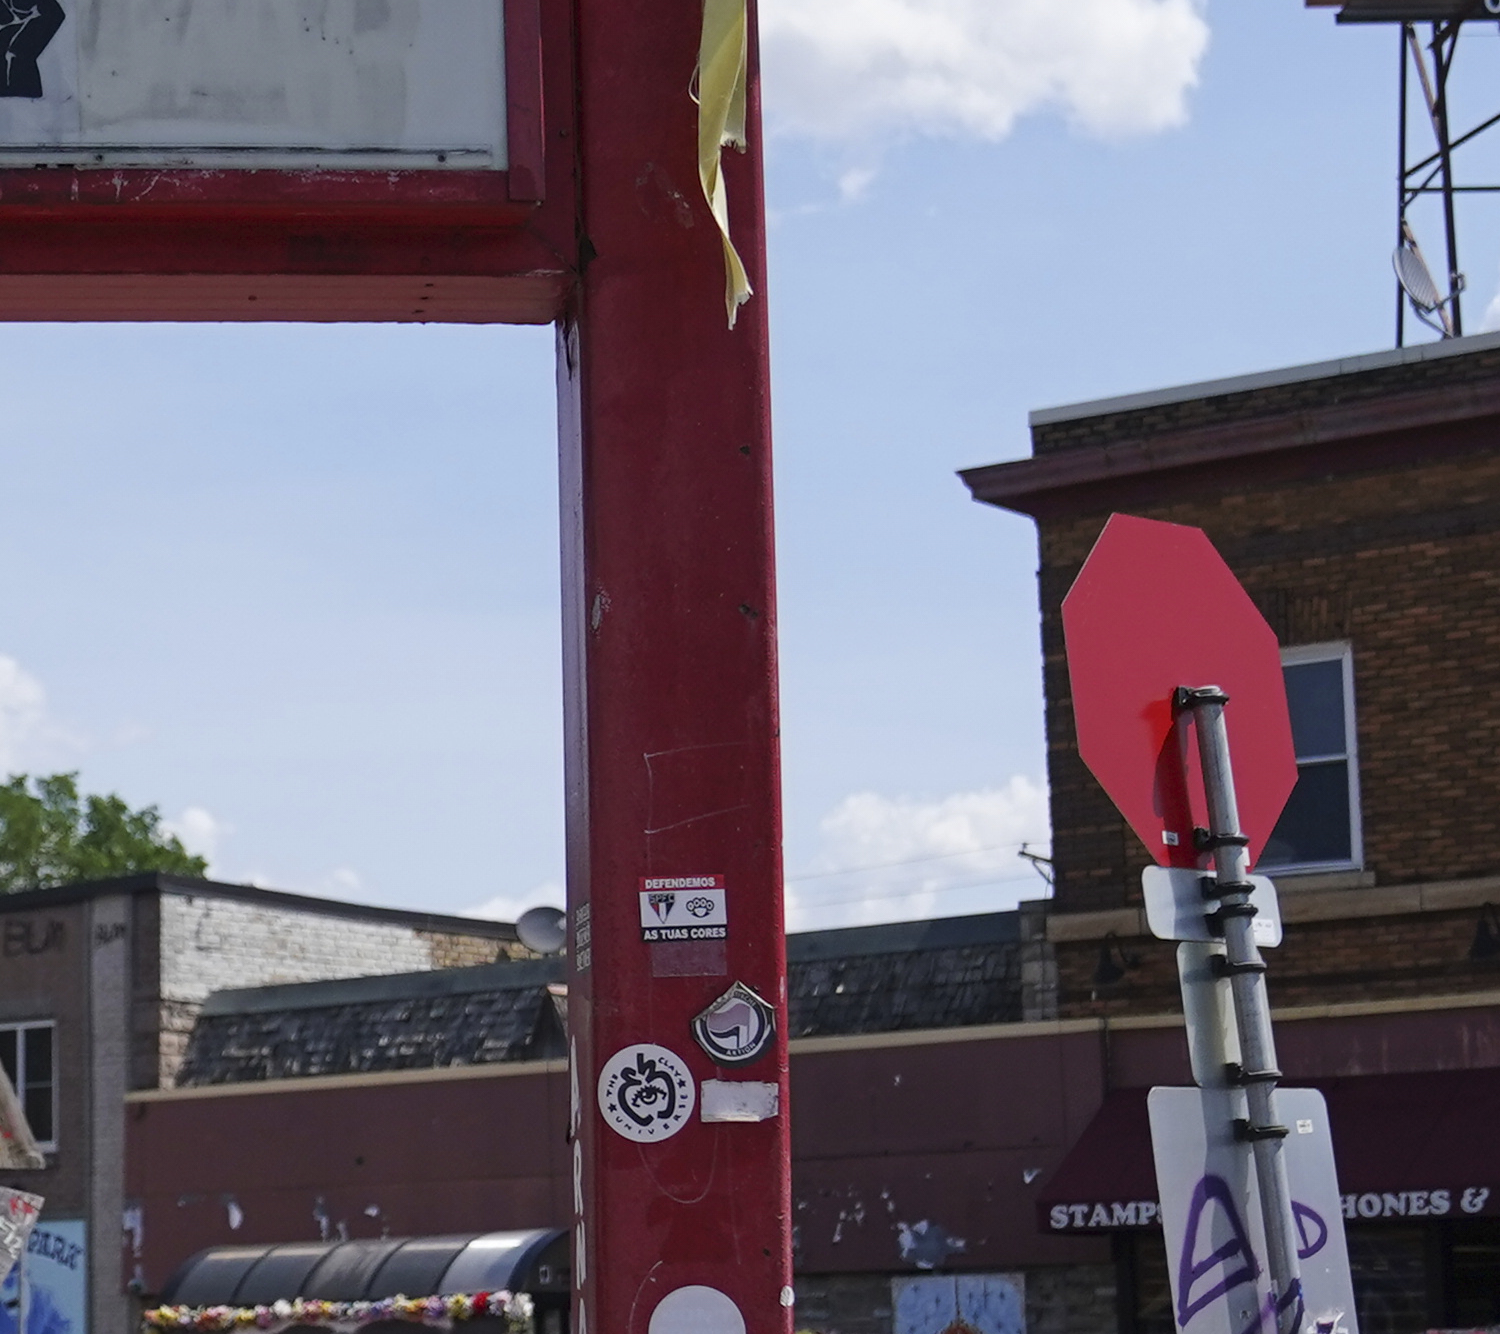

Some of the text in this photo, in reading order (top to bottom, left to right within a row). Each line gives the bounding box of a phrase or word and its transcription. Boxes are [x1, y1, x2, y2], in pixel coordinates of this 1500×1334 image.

[644, 876, 716, 890] DEFENDEMOS
[648, 893, 676, 904] SPFC
[643, 927, 727, 941] AS TUAS CORES
[1339, 1189, 1451, 1221] HONES
[1460, 1186, 1492, 1214] &
